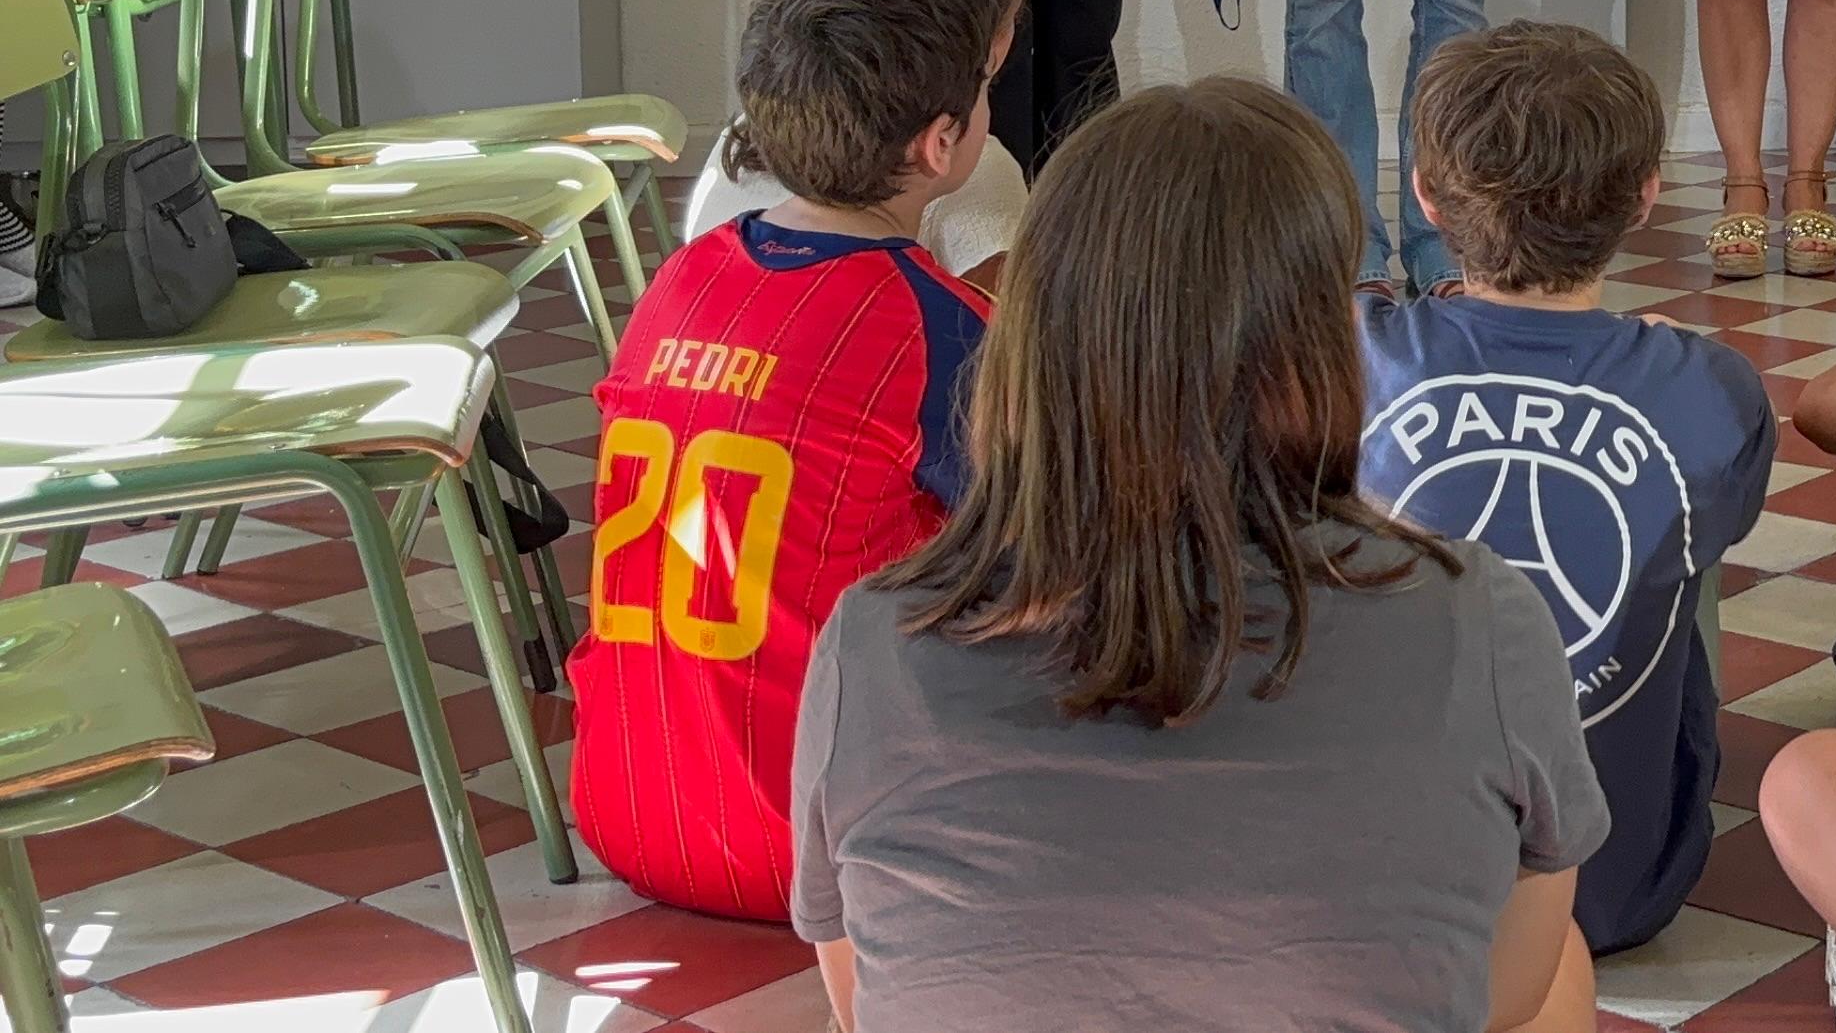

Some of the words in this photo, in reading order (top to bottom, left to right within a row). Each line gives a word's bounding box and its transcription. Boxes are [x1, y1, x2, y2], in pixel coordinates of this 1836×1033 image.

[644, 338, 779, 401] PEDRI
[1390, 391, 1650, 487] PARIS
[592, 417, 795, 661] 20
[1573, 655, 1622, 701] AIN
